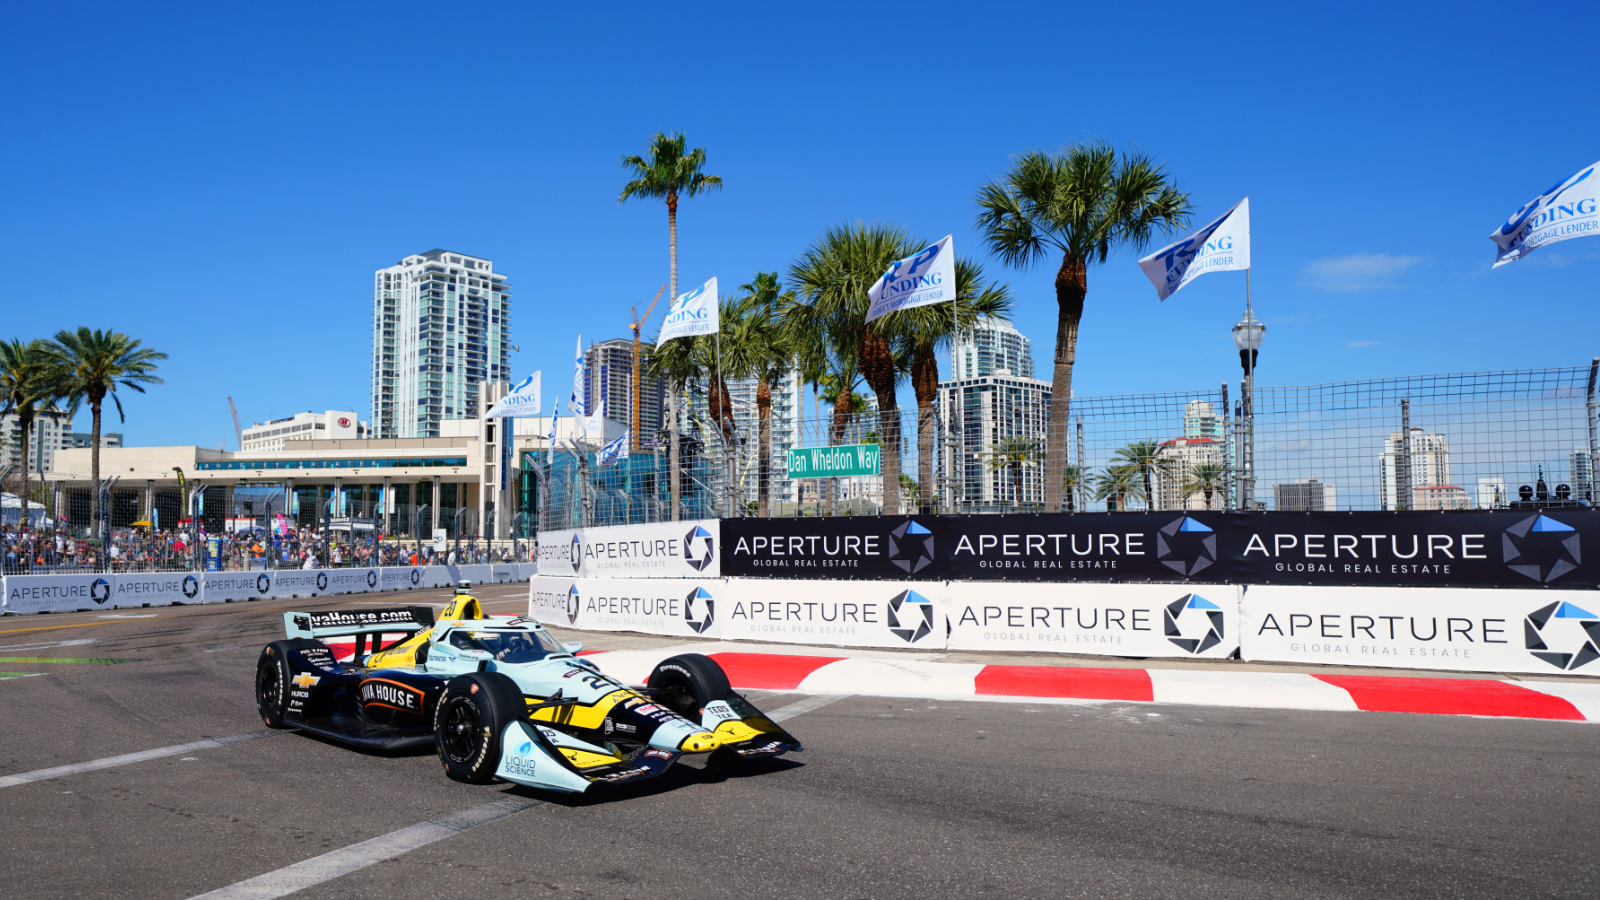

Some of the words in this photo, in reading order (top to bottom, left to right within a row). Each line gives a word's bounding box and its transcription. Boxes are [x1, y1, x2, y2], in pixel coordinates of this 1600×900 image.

[1561, 220, 1599, 234] LENDER
[1205, 256, 1233, 268] LENDER
[880, 272, 942, 300] UNDING
[922, 290, 943, 302] LENDER
[788, 450, 807, 472] Dan
[811, 448, 853, 471] Wheldon
[857, 445, 878, 474] Way
[584, 539, 679, 560] APERTURE
[733, 535, 881, 556] APERTURE
[953, 533, 1146, 556] APERTURE
[1243, 533, 1487, 559] APERTURE
[753, 559, 789, 567] GLOBAL
[795, 559, 818, 567] REAL
[823, 559, 859, 567] ESTATE
[979, 560, 1027, 569] GLOBAL
[1034, 560, 1063, 569] REAL
[1070, 560, 1117, 569] ESTATE
[1275, 562, 1335, 572] GLOBAL
[1344, 563, 1381, 574] REAL
[1391, 564, 1451, 574] ESTATE
[275, 576, 315, 587] APERTURE
[331, 574, 367, 584] APERTURE
[381, 572, 411, 582] APERTURE
[11, 585, 88, 600] APERTURE
[117, 581, 180, 594] APERTURE
[204, 579, 255, 591] APERTURE
[444, 600, 457, 617] 20
[533, 592, 566, 610] APERTURE
[586, 597, 679, 616] APERTURE
[311, 610, 413, 626] vaHouse.com
[731, 601, 878, 623] APERTURE
[959, 605, 1152, 631] APERTURE
[750, 624, 787, 632] GLOBAL
[792, 625, 815, 633] REAL
[820, 626, 856, 635] ESTATE
[1257, 613, 1509, 644] APERTURE
[983, 632, 1031, 641] GLOBAL
[1038, 633, 1068, 643] REAL
[1075, 634, 1123, 644] ESTATE
[1290, 643, 1351, 654] GLOBAL
[1361, 645, 1400, 656] REAL
[1409, 647, 1471, 659] ESTATE
[376, 684, 415, 709] HOUSE
[471, 725, 491, 772] Frestone
[505, 755, 536, 769] LIQUID
[505, 764, 536, 778] SCIENCE
